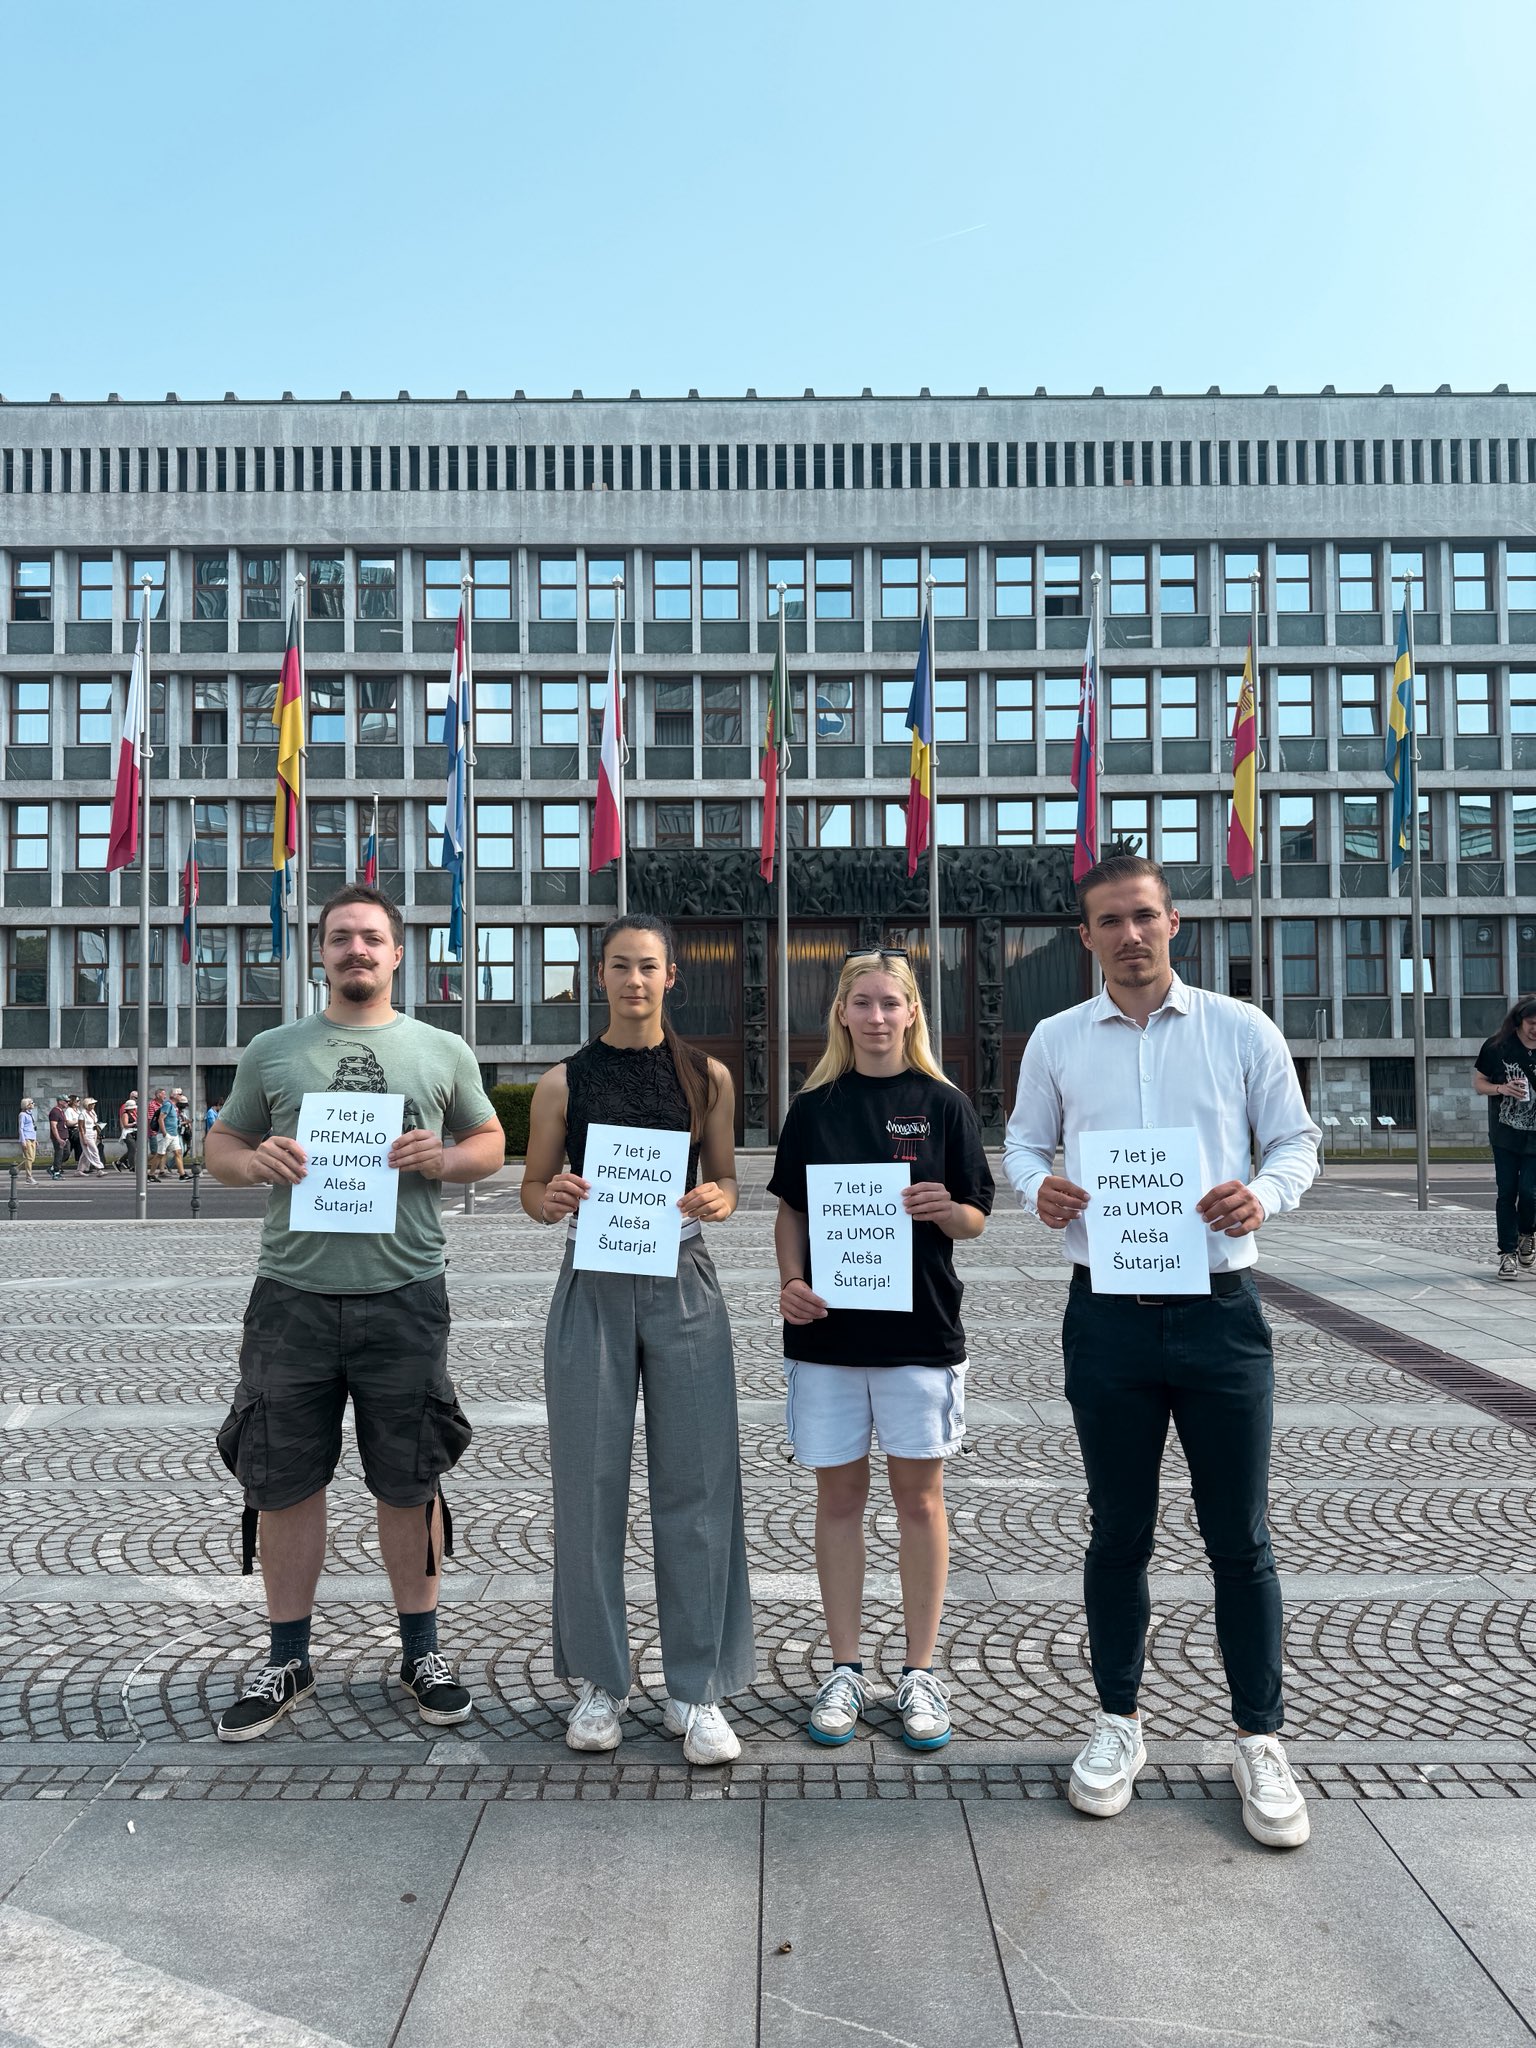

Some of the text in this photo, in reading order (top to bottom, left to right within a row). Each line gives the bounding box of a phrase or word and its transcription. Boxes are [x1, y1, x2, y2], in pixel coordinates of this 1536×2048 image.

[326, 1109, 374, 1124] 7 let je
[310, 1130, 387, 1145] PREMALO
[613, 1144, 661, 1161] 7 let je
[1110, 1147, 1166, 1165] 7 let je
[312, 1155, 381, 1167] za UMOR
[598, 1165, 671, 1182] PREMALO
[324, 1177, 365, 1190] Aleša
[834, 1181, 882, 1196] 7 let je
[1098, 1173, 1184, 1190] PREMALO
[314, 1196, 373, 1214] Šutarja!
[598, 1192, 667, 1206] za UMOR
[822, 1204, 896, 1217] PREMALO
[1103, 1201, 1182, 1217] za UMOR
[609, 1215, 649, 1229] Aleša
[827, 1228, 895, 1241] za UMOR
[1120, 1228, 1168, 1244] Aleša
[599, 1234, 657, 1255] Šutarja!
[842, 1251, 881, 1264] Aleša
[1114, 1252, 1181, 1272] Šutarja!
[834, 1271, 890, 1290] Šutarja!
